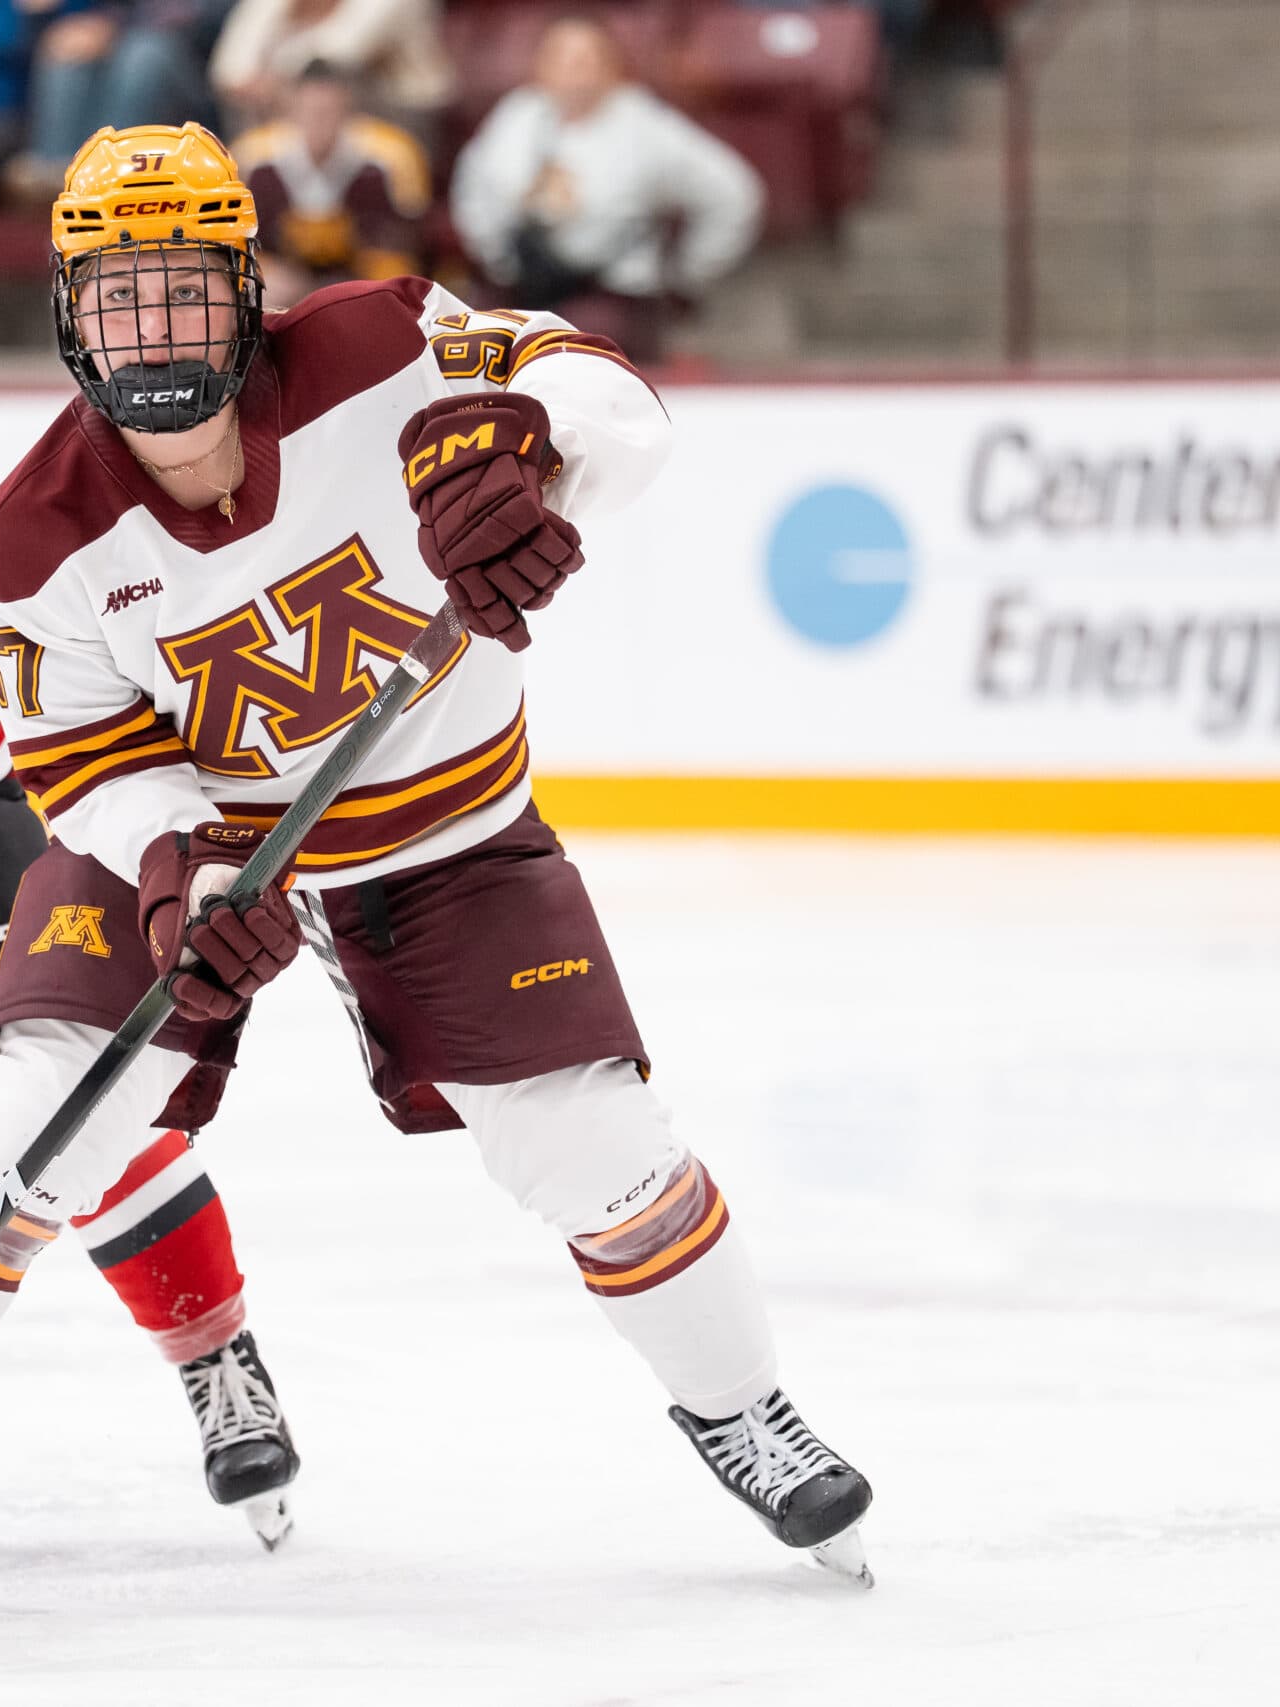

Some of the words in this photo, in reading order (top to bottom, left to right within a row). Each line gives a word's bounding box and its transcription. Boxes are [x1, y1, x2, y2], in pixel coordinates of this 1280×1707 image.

[131, 153, 165, 172] 97
[113, 200, 187, 218] CCM
[131, 388, 195, 404] CCM
[403, 422, 496, 488] CM
[107, 577, 164, 613] WCHA
[370, 701, 383, 719] 8
[206, 826, 255, 838] CCM
[510, 958, 590, 990] CCM
[606, 1168, 656, 1213] CCM
